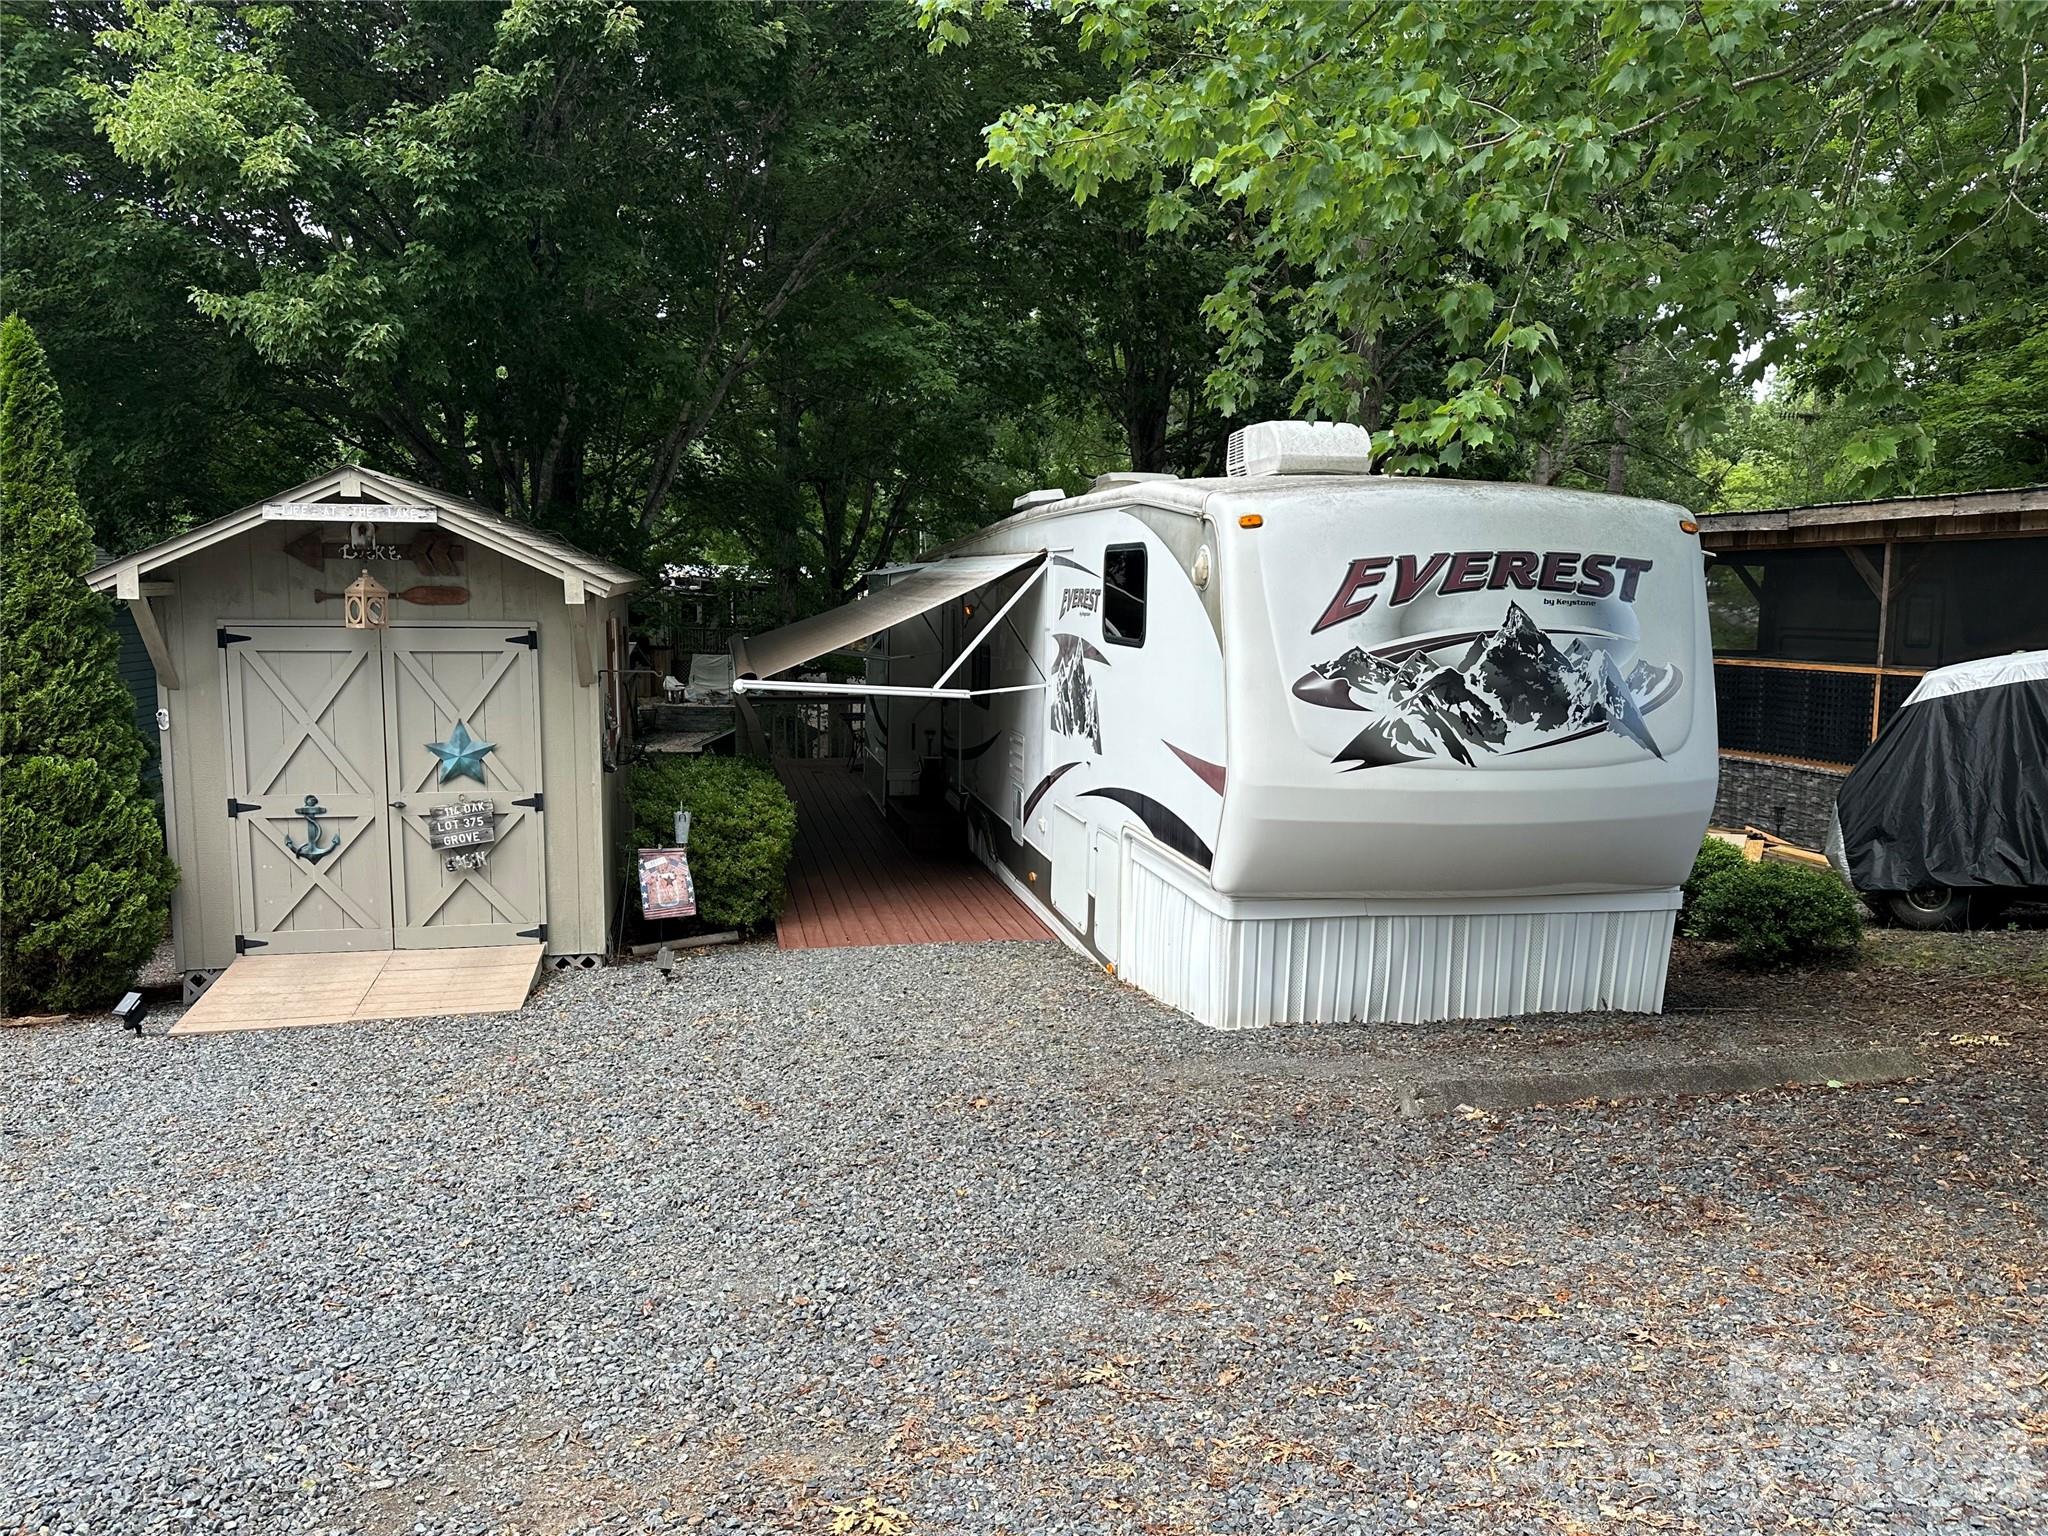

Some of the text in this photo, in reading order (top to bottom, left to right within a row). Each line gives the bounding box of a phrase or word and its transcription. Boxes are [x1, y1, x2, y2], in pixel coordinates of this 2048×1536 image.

[320, 506, 337, 517] AT
[351, 506, 371, 518] THE
[1311, 551, 1653, 635] EVEREST
[1059, 588, 1101, 620] EVEREST
[1543, 598, 1597, 607] by Keystone
[464, 802, 485, 813] OAK
[437, 816, 484, 832] LOT 375
[443, 831, 481, 846] GROVE
